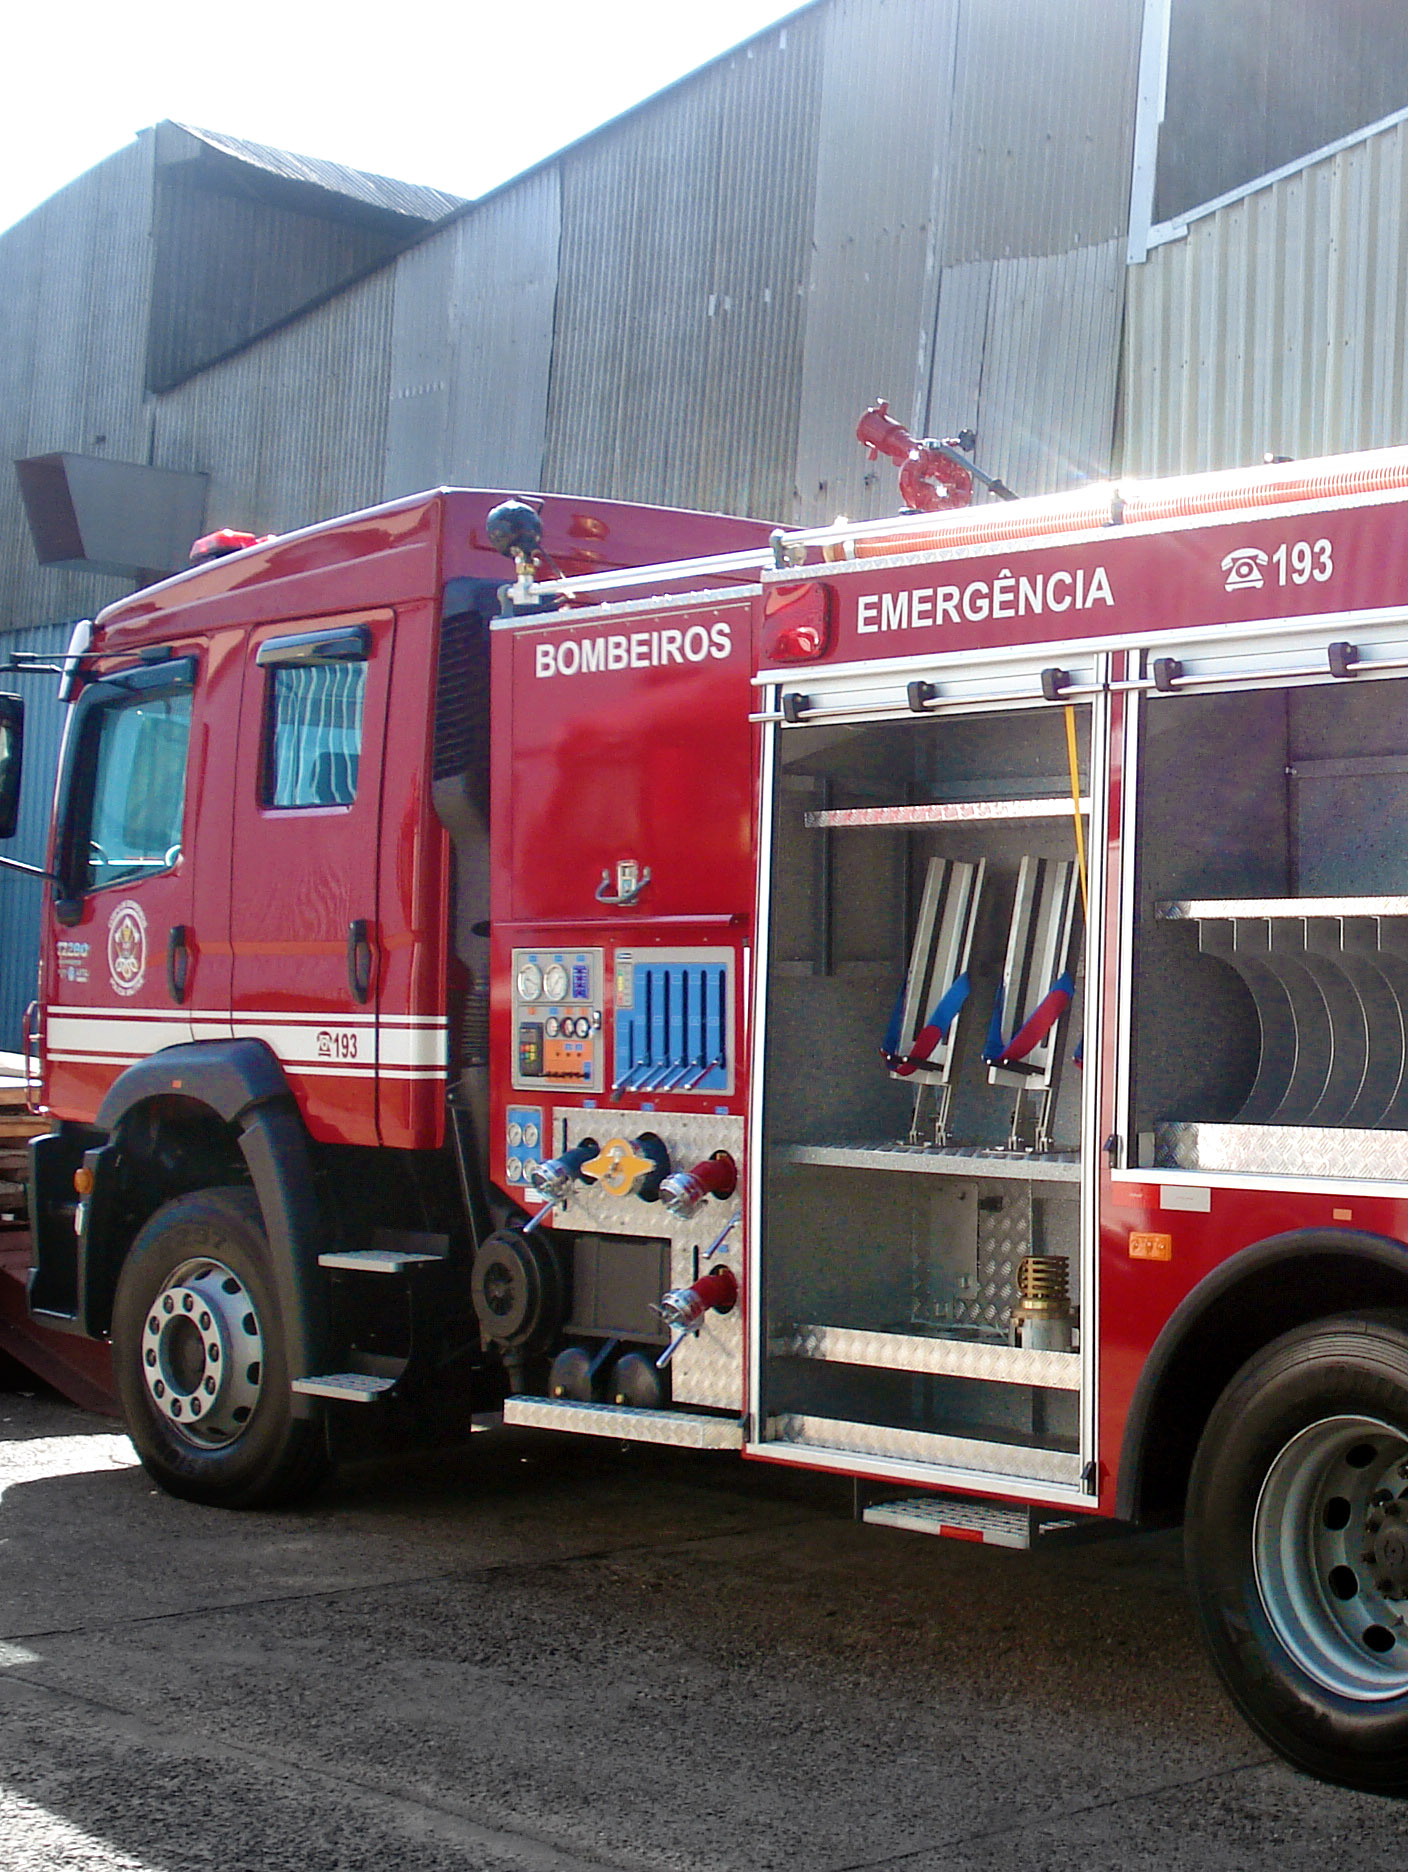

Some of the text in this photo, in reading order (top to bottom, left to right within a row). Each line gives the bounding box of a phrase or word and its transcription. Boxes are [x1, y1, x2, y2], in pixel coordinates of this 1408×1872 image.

[1272, 538, 1334, 587] 193
[857, 567, 1116, 634] EMERGÊNCIA
[535, 622, 733, 678] BOMBEIROS
[333, 1032, 358, 1058] 193
